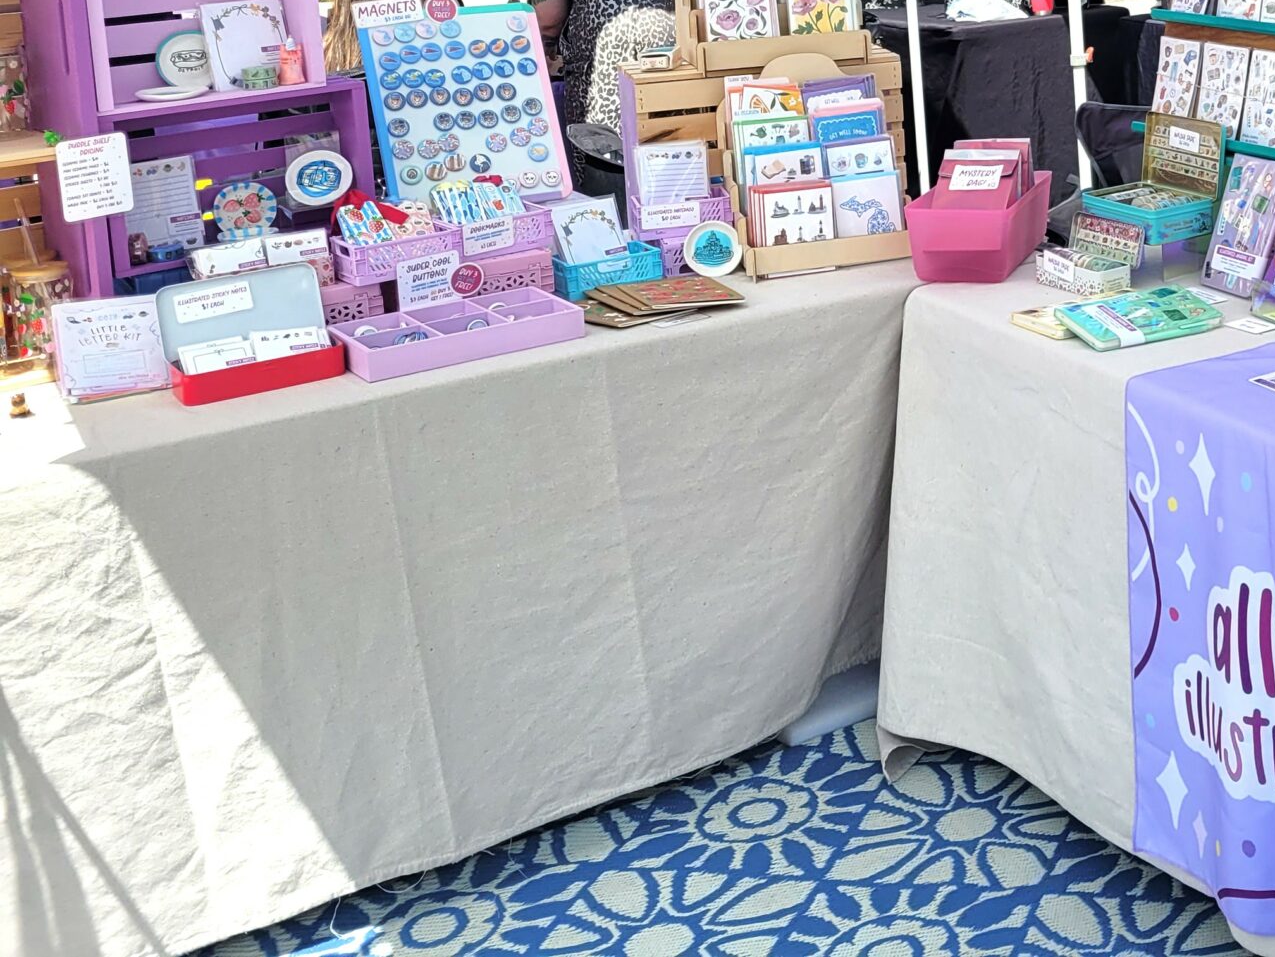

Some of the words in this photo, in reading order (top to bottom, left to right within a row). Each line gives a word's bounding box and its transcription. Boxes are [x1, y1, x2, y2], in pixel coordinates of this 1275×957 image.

[358, 0, 417, 19] MAGNETS
[839, 130, 852, 138] WELL
[92, 136, 111, 145] SHELF
[80, 146, 104, 156] PRICING
[958, 168, 998, 178] MYSTERY
[966, 179, 988, 187] BAG!
[470, 220, 505, 234] BOOKMARKS
[406, 262, 430, 274] SUPER
[432, 256, 452, 268] COOL
[412, 268, 448, 283] BUTTONS!
[458, 267, 474, 276] BUY
[454, 280, 473, 291] FREE!
[177, 294, 211, 306] ILLUSTRATED
[211, 290, 230, 299] STICKY
[230, 286, 248, 294] NOTES
[210, 301, 225, 309] EACH
[90, 325, 128, 335] LITTLE
[78, 333, 119, 347] LETTER
[123, 332, 142, 341] KIT
